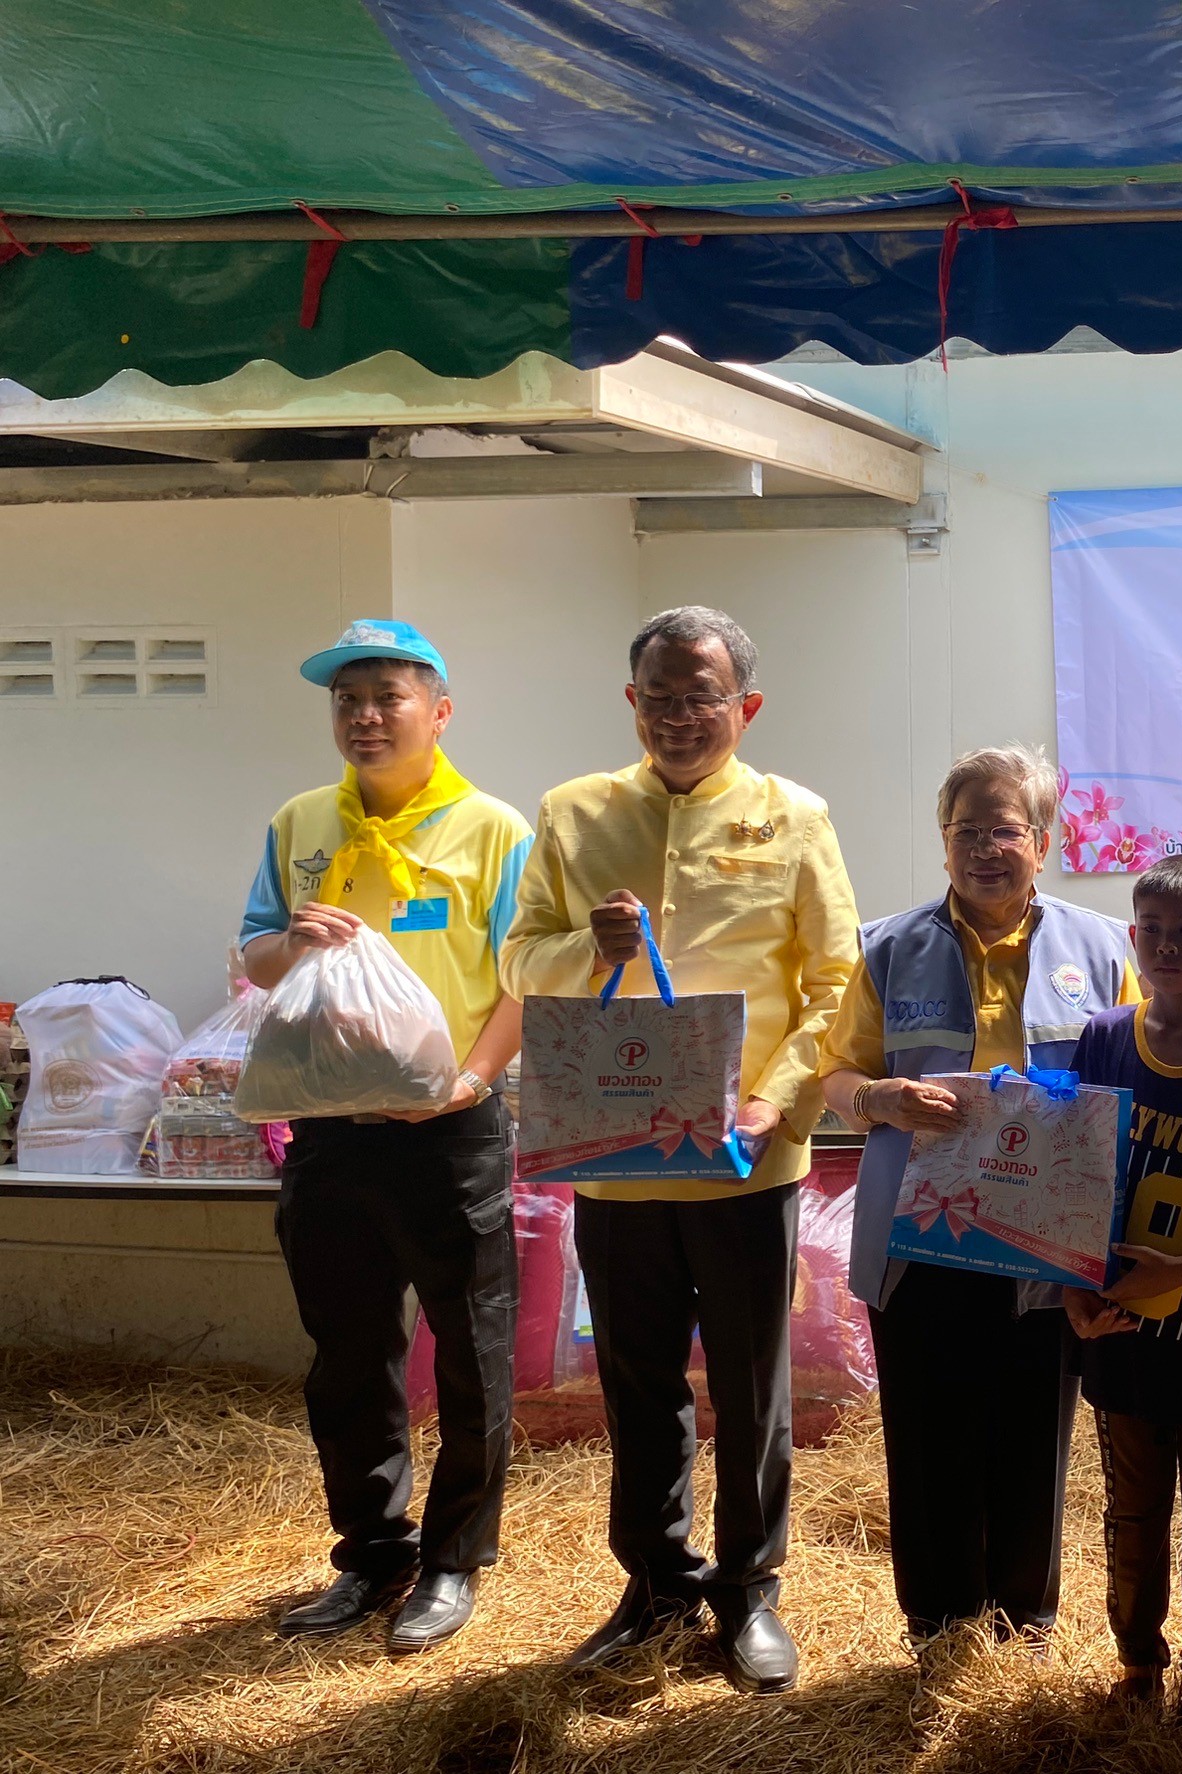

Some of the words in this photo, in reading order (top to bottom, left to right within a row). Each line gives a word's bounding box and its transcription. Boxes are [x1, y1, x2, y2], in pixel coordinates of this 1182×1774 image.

[597, 1074, 662, 1088] พวงทอง
[978, 1157, 1038, 1178] พวงทอง
[980, 1171, 1030, 1187] สรรพสินค้า
